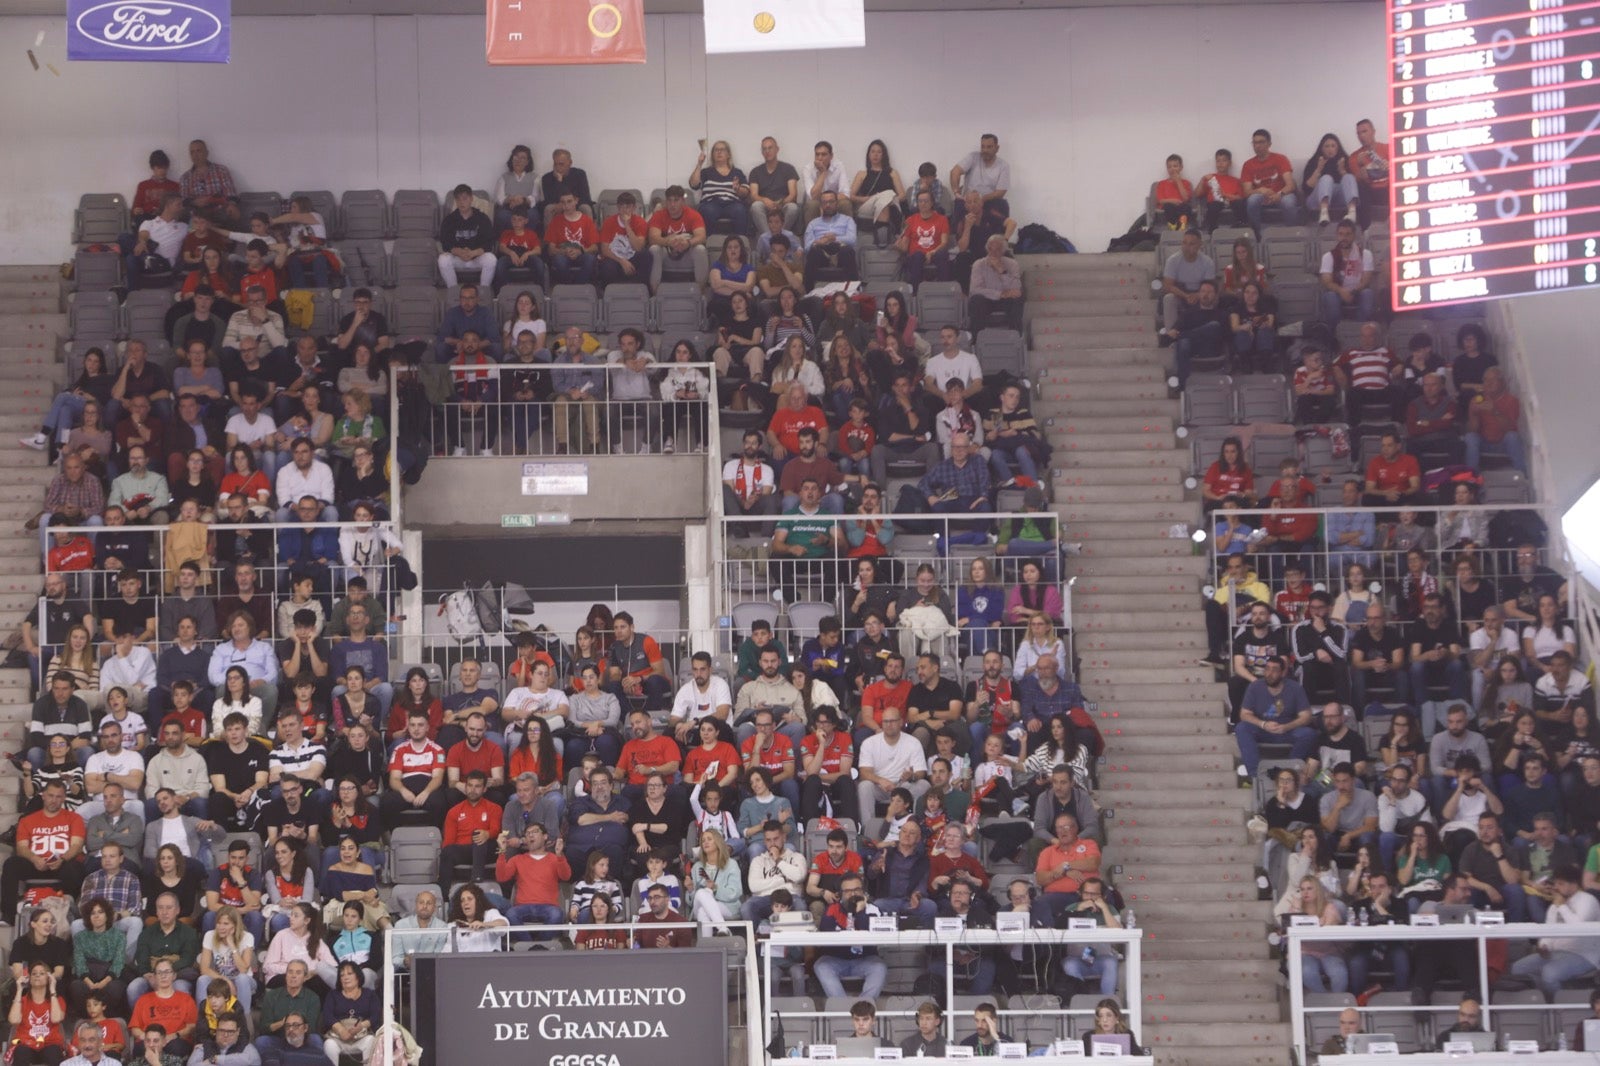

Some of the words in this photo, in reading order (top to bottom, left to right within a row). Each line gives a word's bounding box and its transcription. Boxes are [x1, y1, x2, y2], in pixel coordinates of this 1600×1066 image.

[104, 5, 193, 44] Ford
[1403, 37, 1412, 55] 1
[1402, 62, 1413, 80] 2
[1403, 111, 1414, 130] 7
[1401, 136, 1417, 155] 11
[1584, 238, 1597, 258] 2
[477, 982, 687, 1009] AYUNTAMIENTO
[494, 1022, 530, 1042] DE
[538, 1014, 669, 1041] GRANADA
